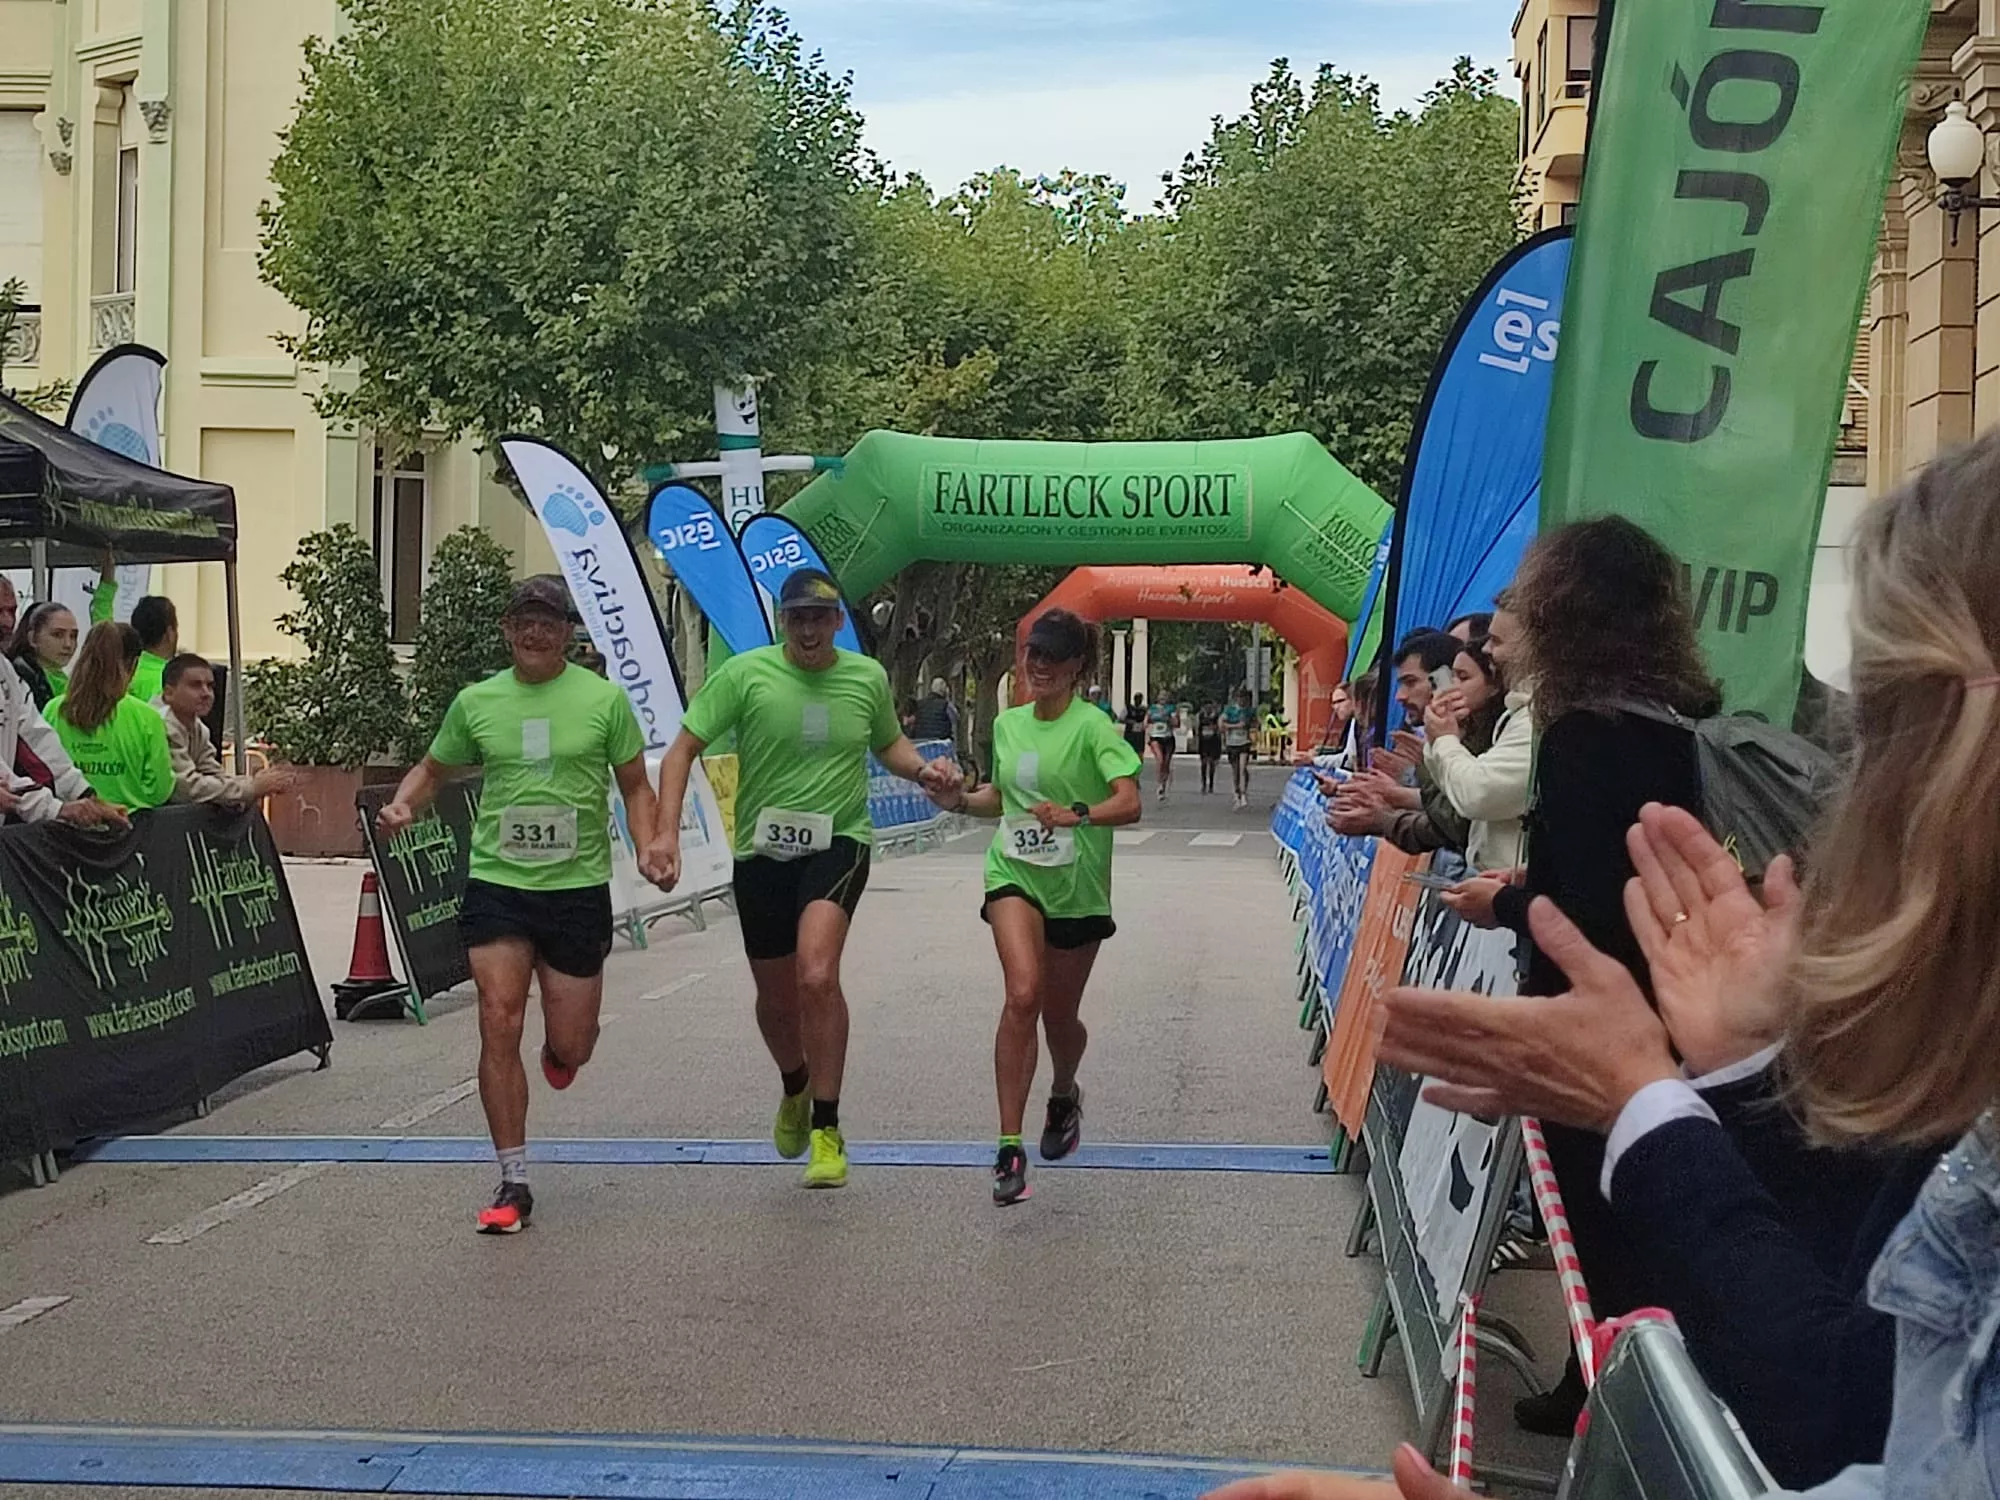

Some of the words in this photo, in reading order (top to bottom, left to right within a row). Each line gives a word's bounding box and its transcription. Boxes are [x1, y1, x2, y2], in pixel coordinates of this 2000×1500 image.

[933, 471, 1113, 519] FARTLECK
[1122, 474, 1237, 519] SPORT
[1053, 527, 1063, 537] Y
[1135, 526, 1155, 537] DE
[1159, 523, 1228, 537] EVENTOS
[1219, 574, 1270, 588] Huesca
[1682, 563, 1779, 634] VIP
[511, 823, 557, 841] 331
[767, 823, 812, 846] 330
[1013, 828, 1056, 848] 332
